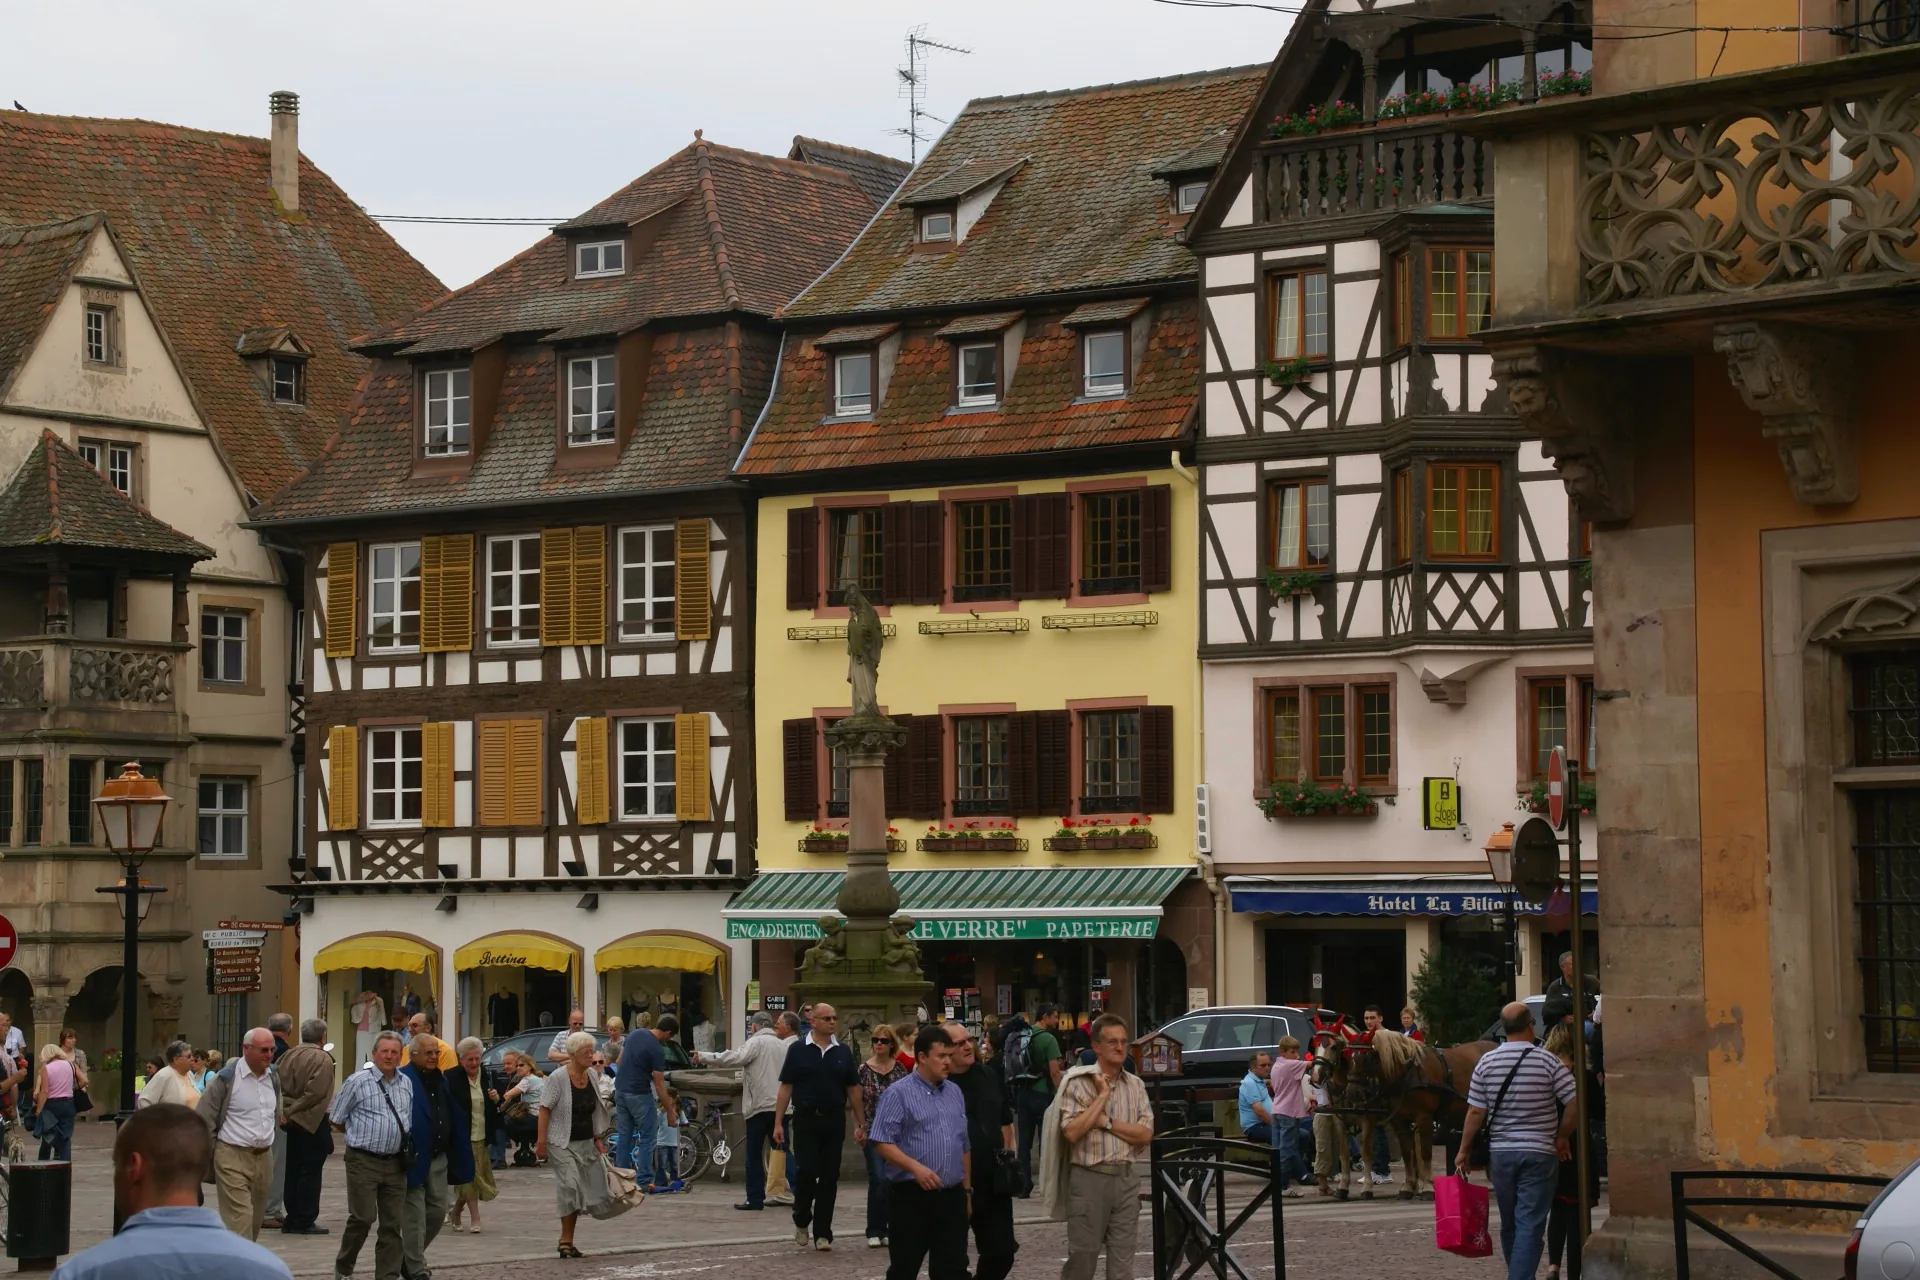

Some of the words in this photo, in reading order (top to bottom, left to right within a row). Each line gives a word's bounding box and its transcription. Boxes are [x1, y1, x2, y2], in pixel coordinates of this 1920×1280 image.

[1434, 799, 1457, 826] Logis
[1367, 895, 1416, 911] Hotel
[1426, 896, 1451, 911] La
[730, 923, 828, 938] ENCADREMEN
[1046, 921, 1153, 938] PAPETERIE
[479, 951, 527, 965] Bettina
